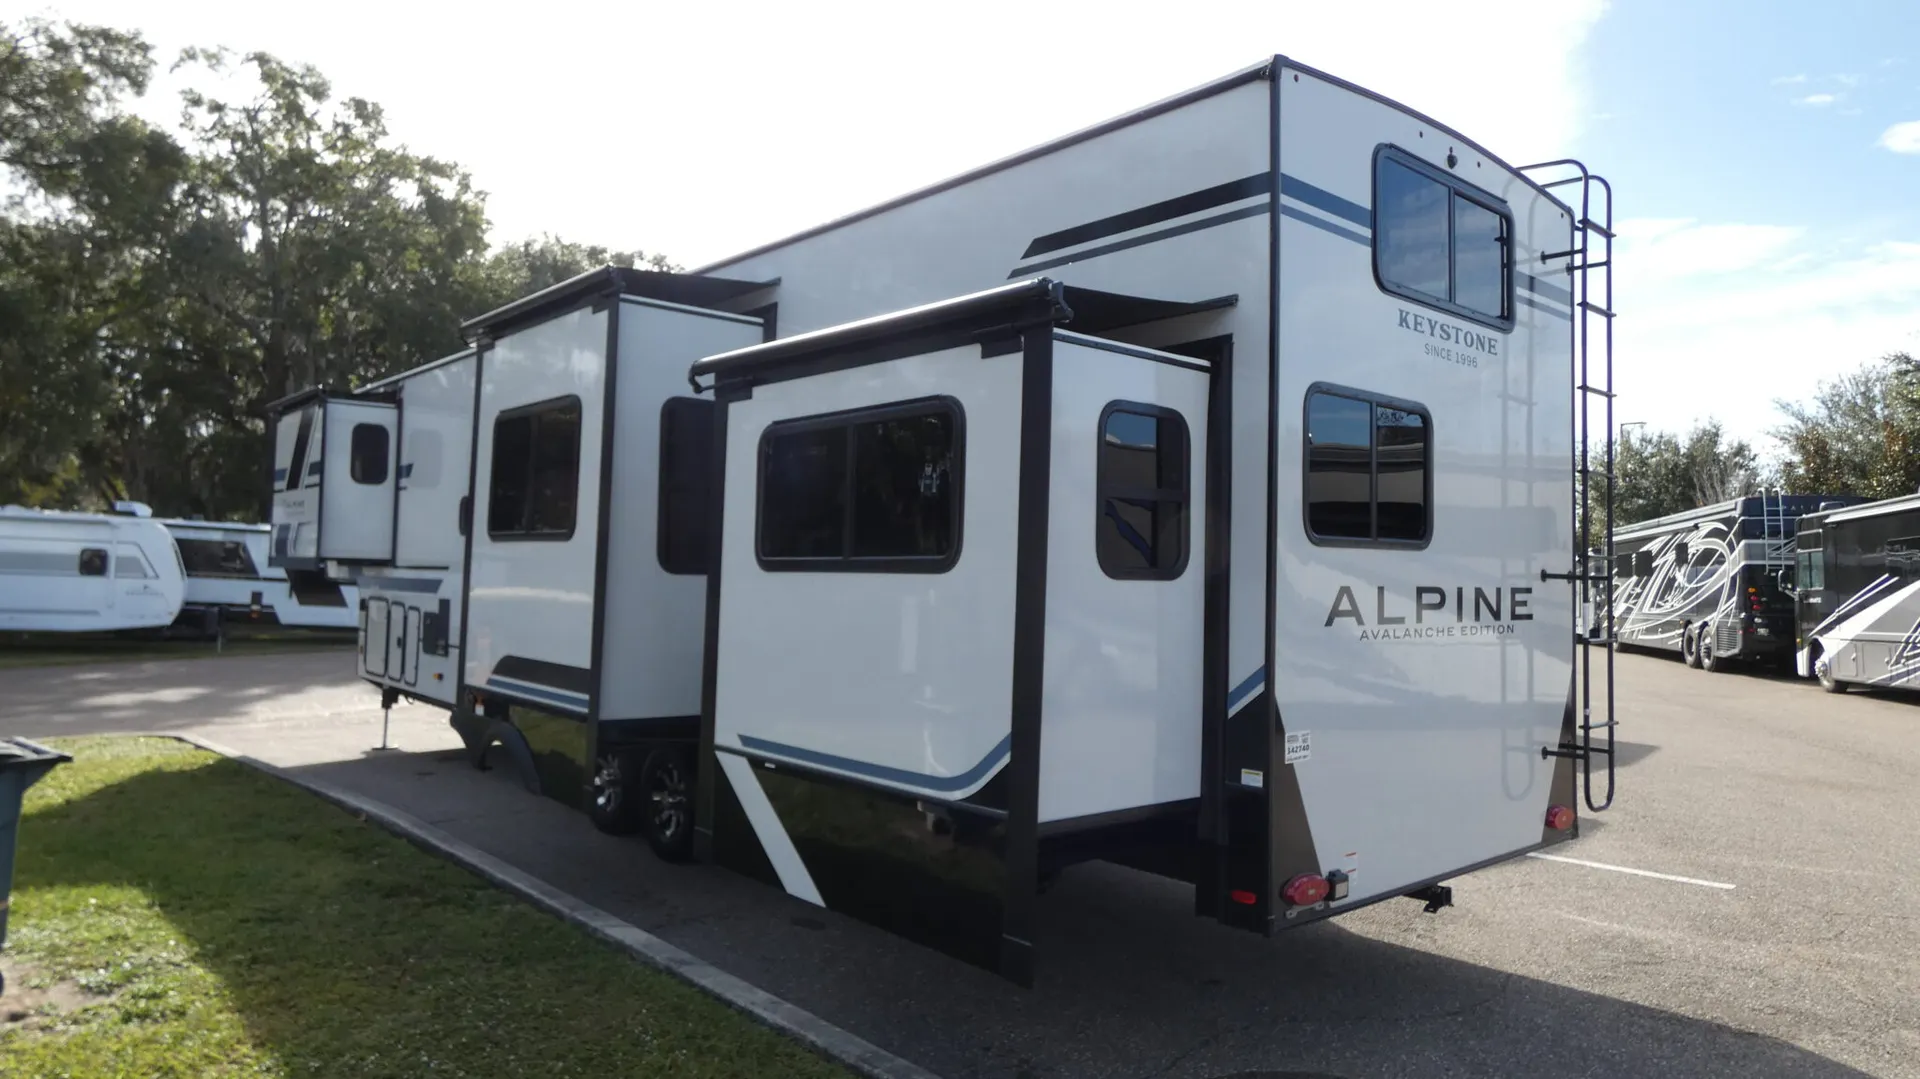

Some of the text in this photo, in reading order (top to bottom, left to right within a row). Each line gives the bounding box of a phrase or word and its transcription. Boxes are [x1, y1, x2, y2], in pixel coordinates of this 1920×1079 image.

[1398, 308, 1498, 356] KEYSTONE
[1424, 343, 1478, 368] SINCE 1996
[1324, 585, 1534, 627] ALPINE
[1359, 624, 1515, 641] AVALANCHE EDITION
